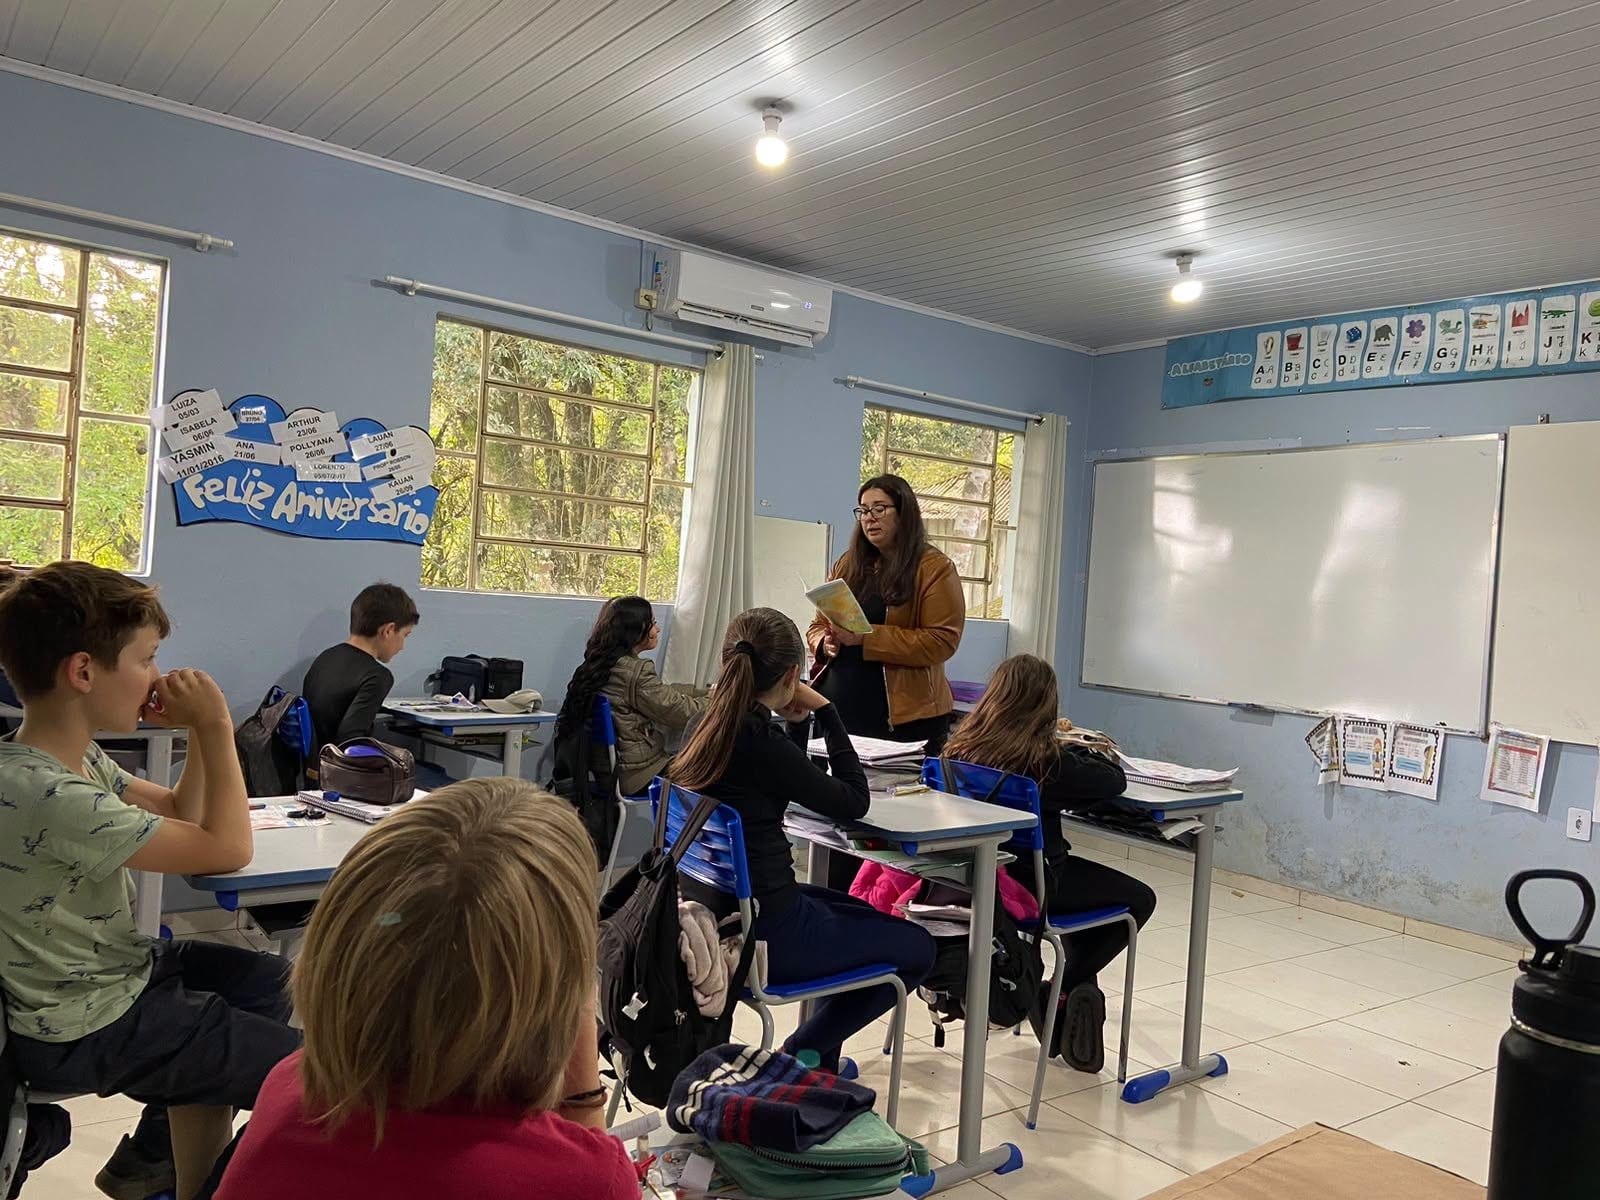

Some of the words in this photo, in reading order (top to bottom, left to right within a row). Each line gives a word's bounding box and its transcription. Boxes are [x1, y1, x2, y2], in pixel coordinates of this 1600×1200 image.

[1544, 336, 1552, 348] J
[1581, 332, 1592, 344] K
[1437, 348, 1447, 358] G
[1472, 344, 1483, 355] H
[1579, 347, 1586, 356] k
[1338, 355, 1346, 365] D
[1367, 352, 1378, 362] E
[1401, 351, 1411, 360] F
[1285, 362, 1293, 372] B
[1313, 359, 1320, 368] C
[1433, 362, 1441, 371] g
[1256, 366, 1264, 374] A
[1338, 368, 1344, 377] d
[1284, 375, 1289, 383] b
[1311, 372, 1317, 380] c
[171, 398, 197, 411] LUIZA
[178, 408, 200, 420] 05/03
[180, 417, 217, 435] ISABELA
[287, 416, 321, 429] ARTHUR
[296, 427, 317, 437] 23/06
[368, 432, 394, 443] LAUAN
[236, 442, 255, 450] ANA
[290, 436, 334, 452] POLLYANA
[374, 441, 393, 451] 27/06
[170, 442, 215, 464] YASMIN
[234, 451, 256, 460] 21/06
[304, 448, 325, 459] 26/06
[176, 455, 224, 477] 11/01/2016
[388, 475, 414, 488] KAUAN
